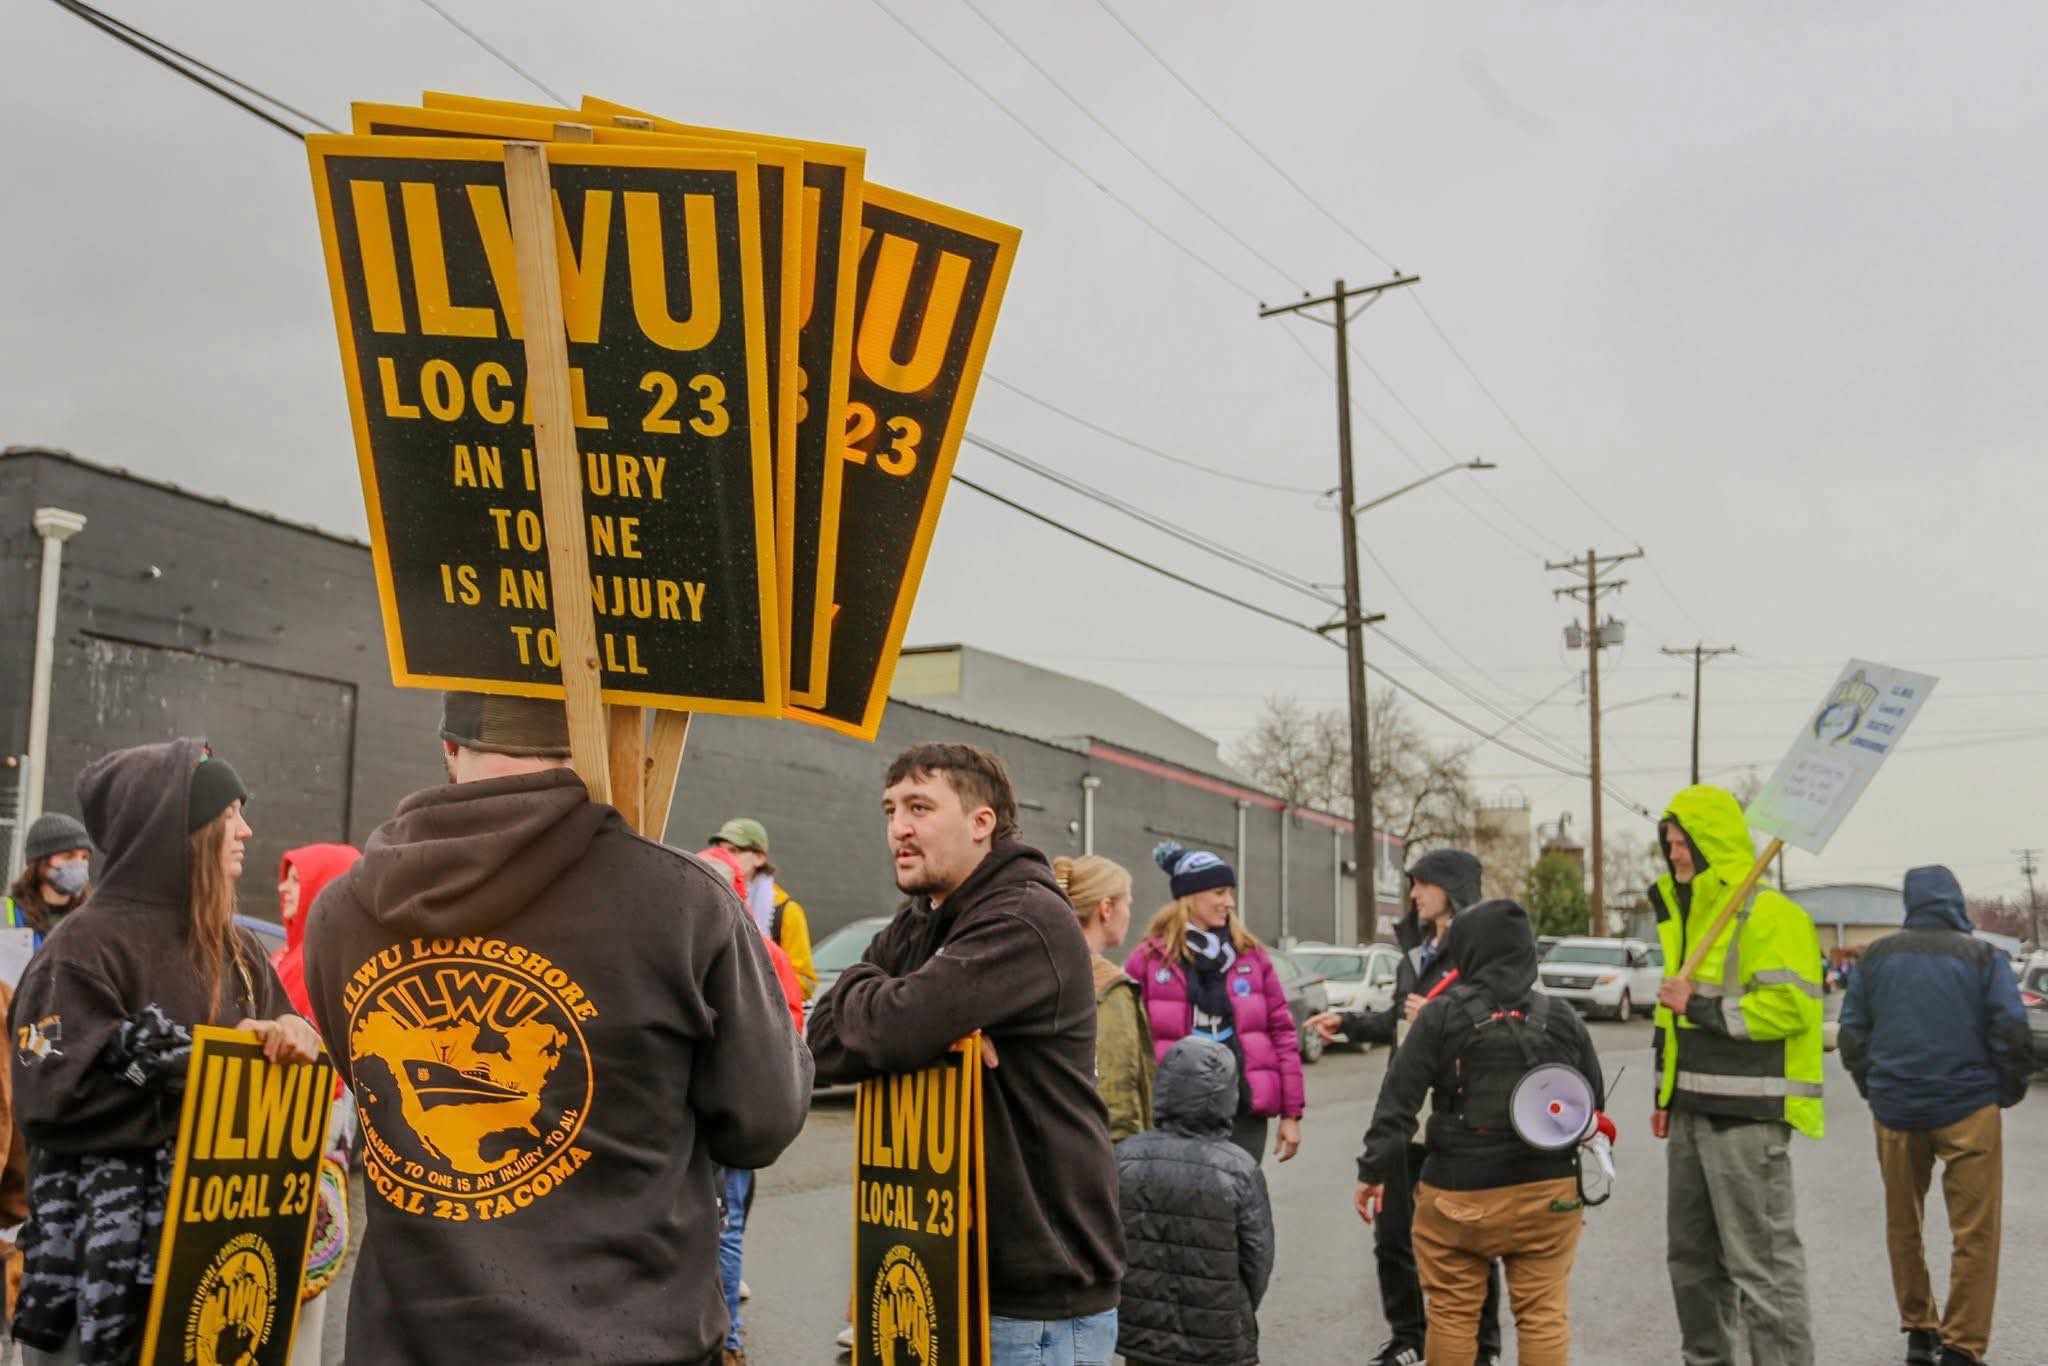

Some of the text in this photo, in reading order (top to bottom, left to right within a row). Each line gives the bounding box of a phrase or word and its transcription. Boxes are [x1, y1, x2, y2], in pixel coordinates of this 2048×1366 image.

[349, 179, 722, 351] ILWU
[377, 356, 608, 431] LOCL
[639, 371, 730, 437] 23
[453, 444, 666, 499] AN IURY
[843, 402, 922, 476] 23
[489, 508, 642, 559] TO NE
[440, 564, 706, 622] IS AN NJURY
[511, 625, 648, 675] TO LL
[377, 969, 548, 1032] ILWU
[410, 936, 598, 1021] LONGSHORE
[193, 1055, 328, 1160] ILWU
[861, 1067, 957, 1175] ILWU
[362, 1145, 592, 1220] LOCAL 23 TACOMA
[404, 1161, 424, 1178] TO
[427, 1171, 453, 1188] ONE
[457, 1178, 471, 1191] IS
[477, 1172, 496, 1190] AN
[499, 1146, 545, 1182] INJURY
[545, 1130, 565, 1147] TO
[560, 1108, 578, 1132] ALL
[183, 1172, 310, 1223] LOCAL 23
[860, 1180, 919, 1232] LOCAL
[926, 1189, 955, 1237] 23
